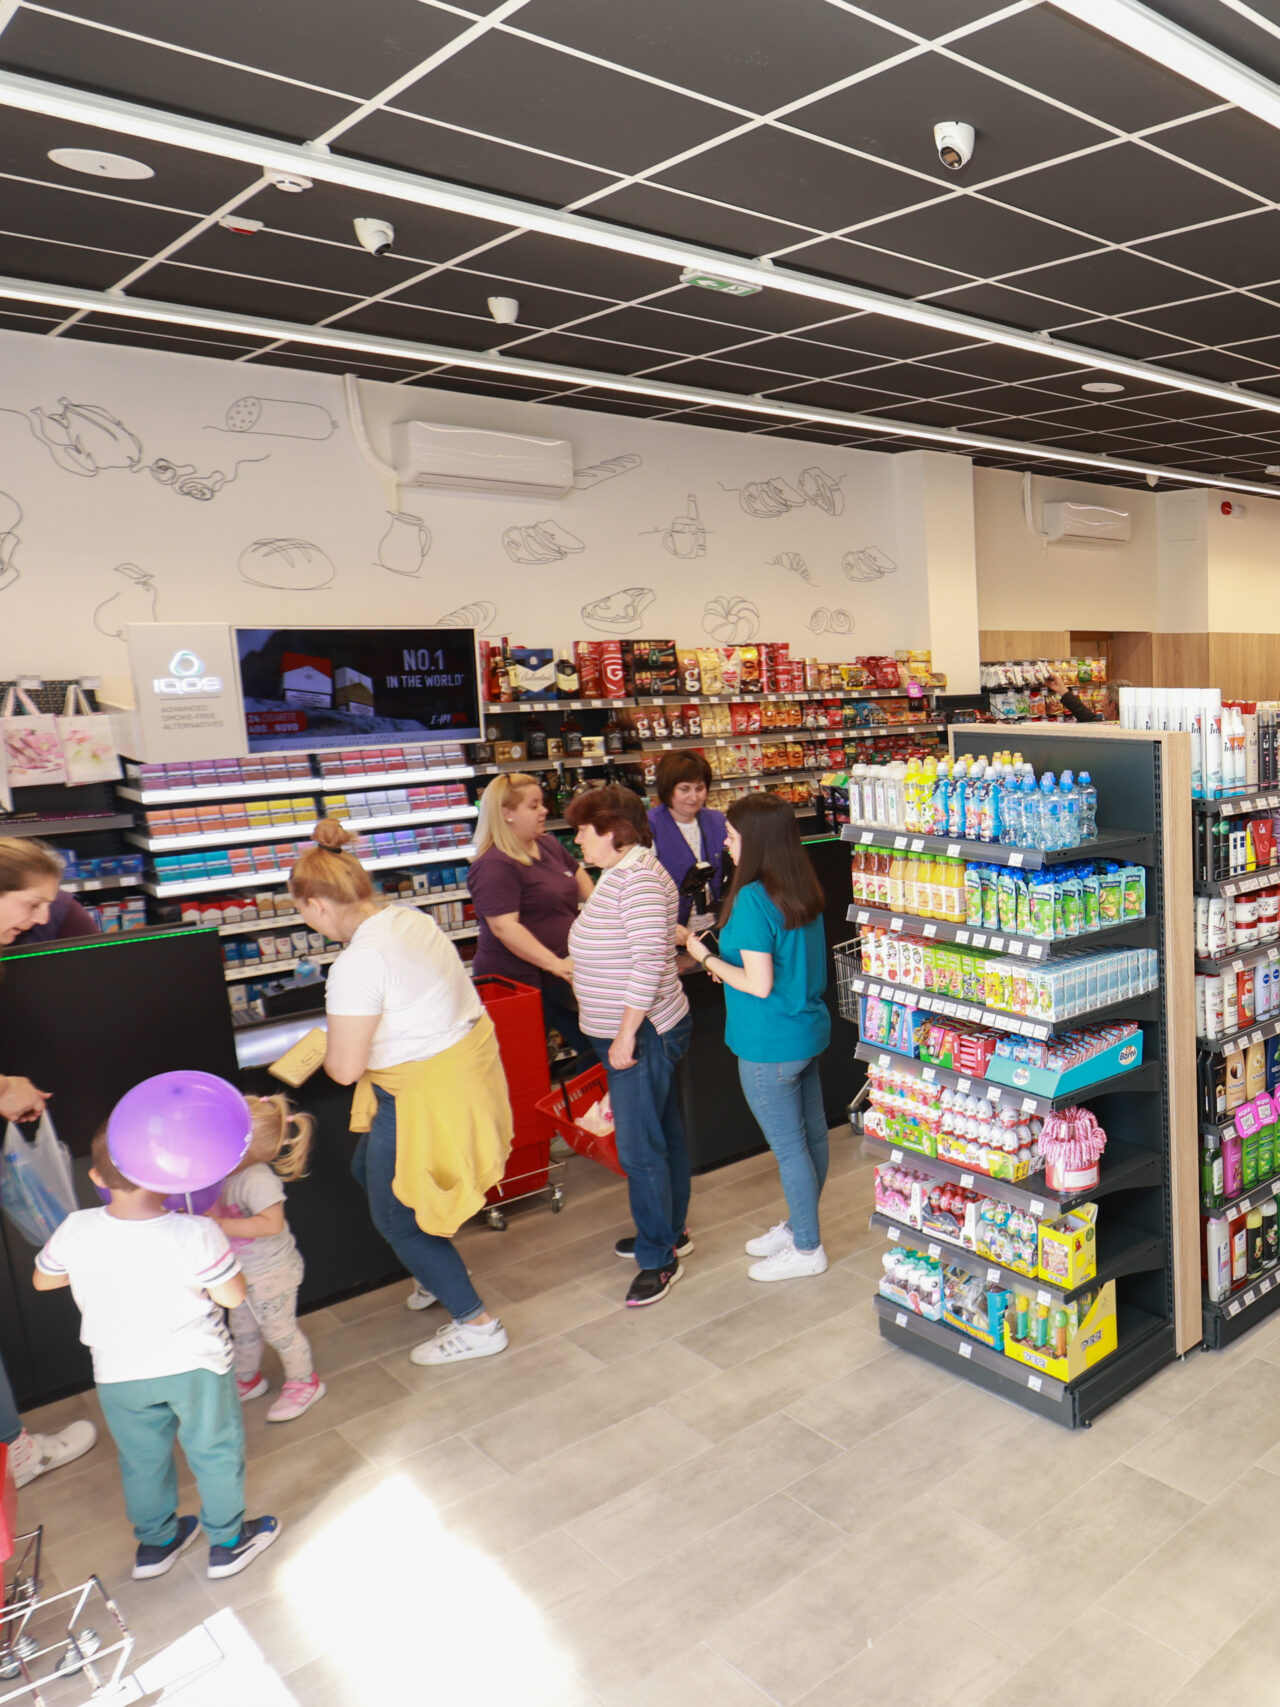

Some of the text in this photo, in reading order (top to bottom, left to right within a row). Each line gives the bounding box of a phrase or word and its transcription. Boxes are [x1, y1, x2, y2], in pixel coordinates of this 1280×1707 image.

[402, 648, 446, 671] NO.1
[153, 677, 222, 695] IQOS
[386, 675, 399, 688] IN
[400, 675, 423, 687] THE
